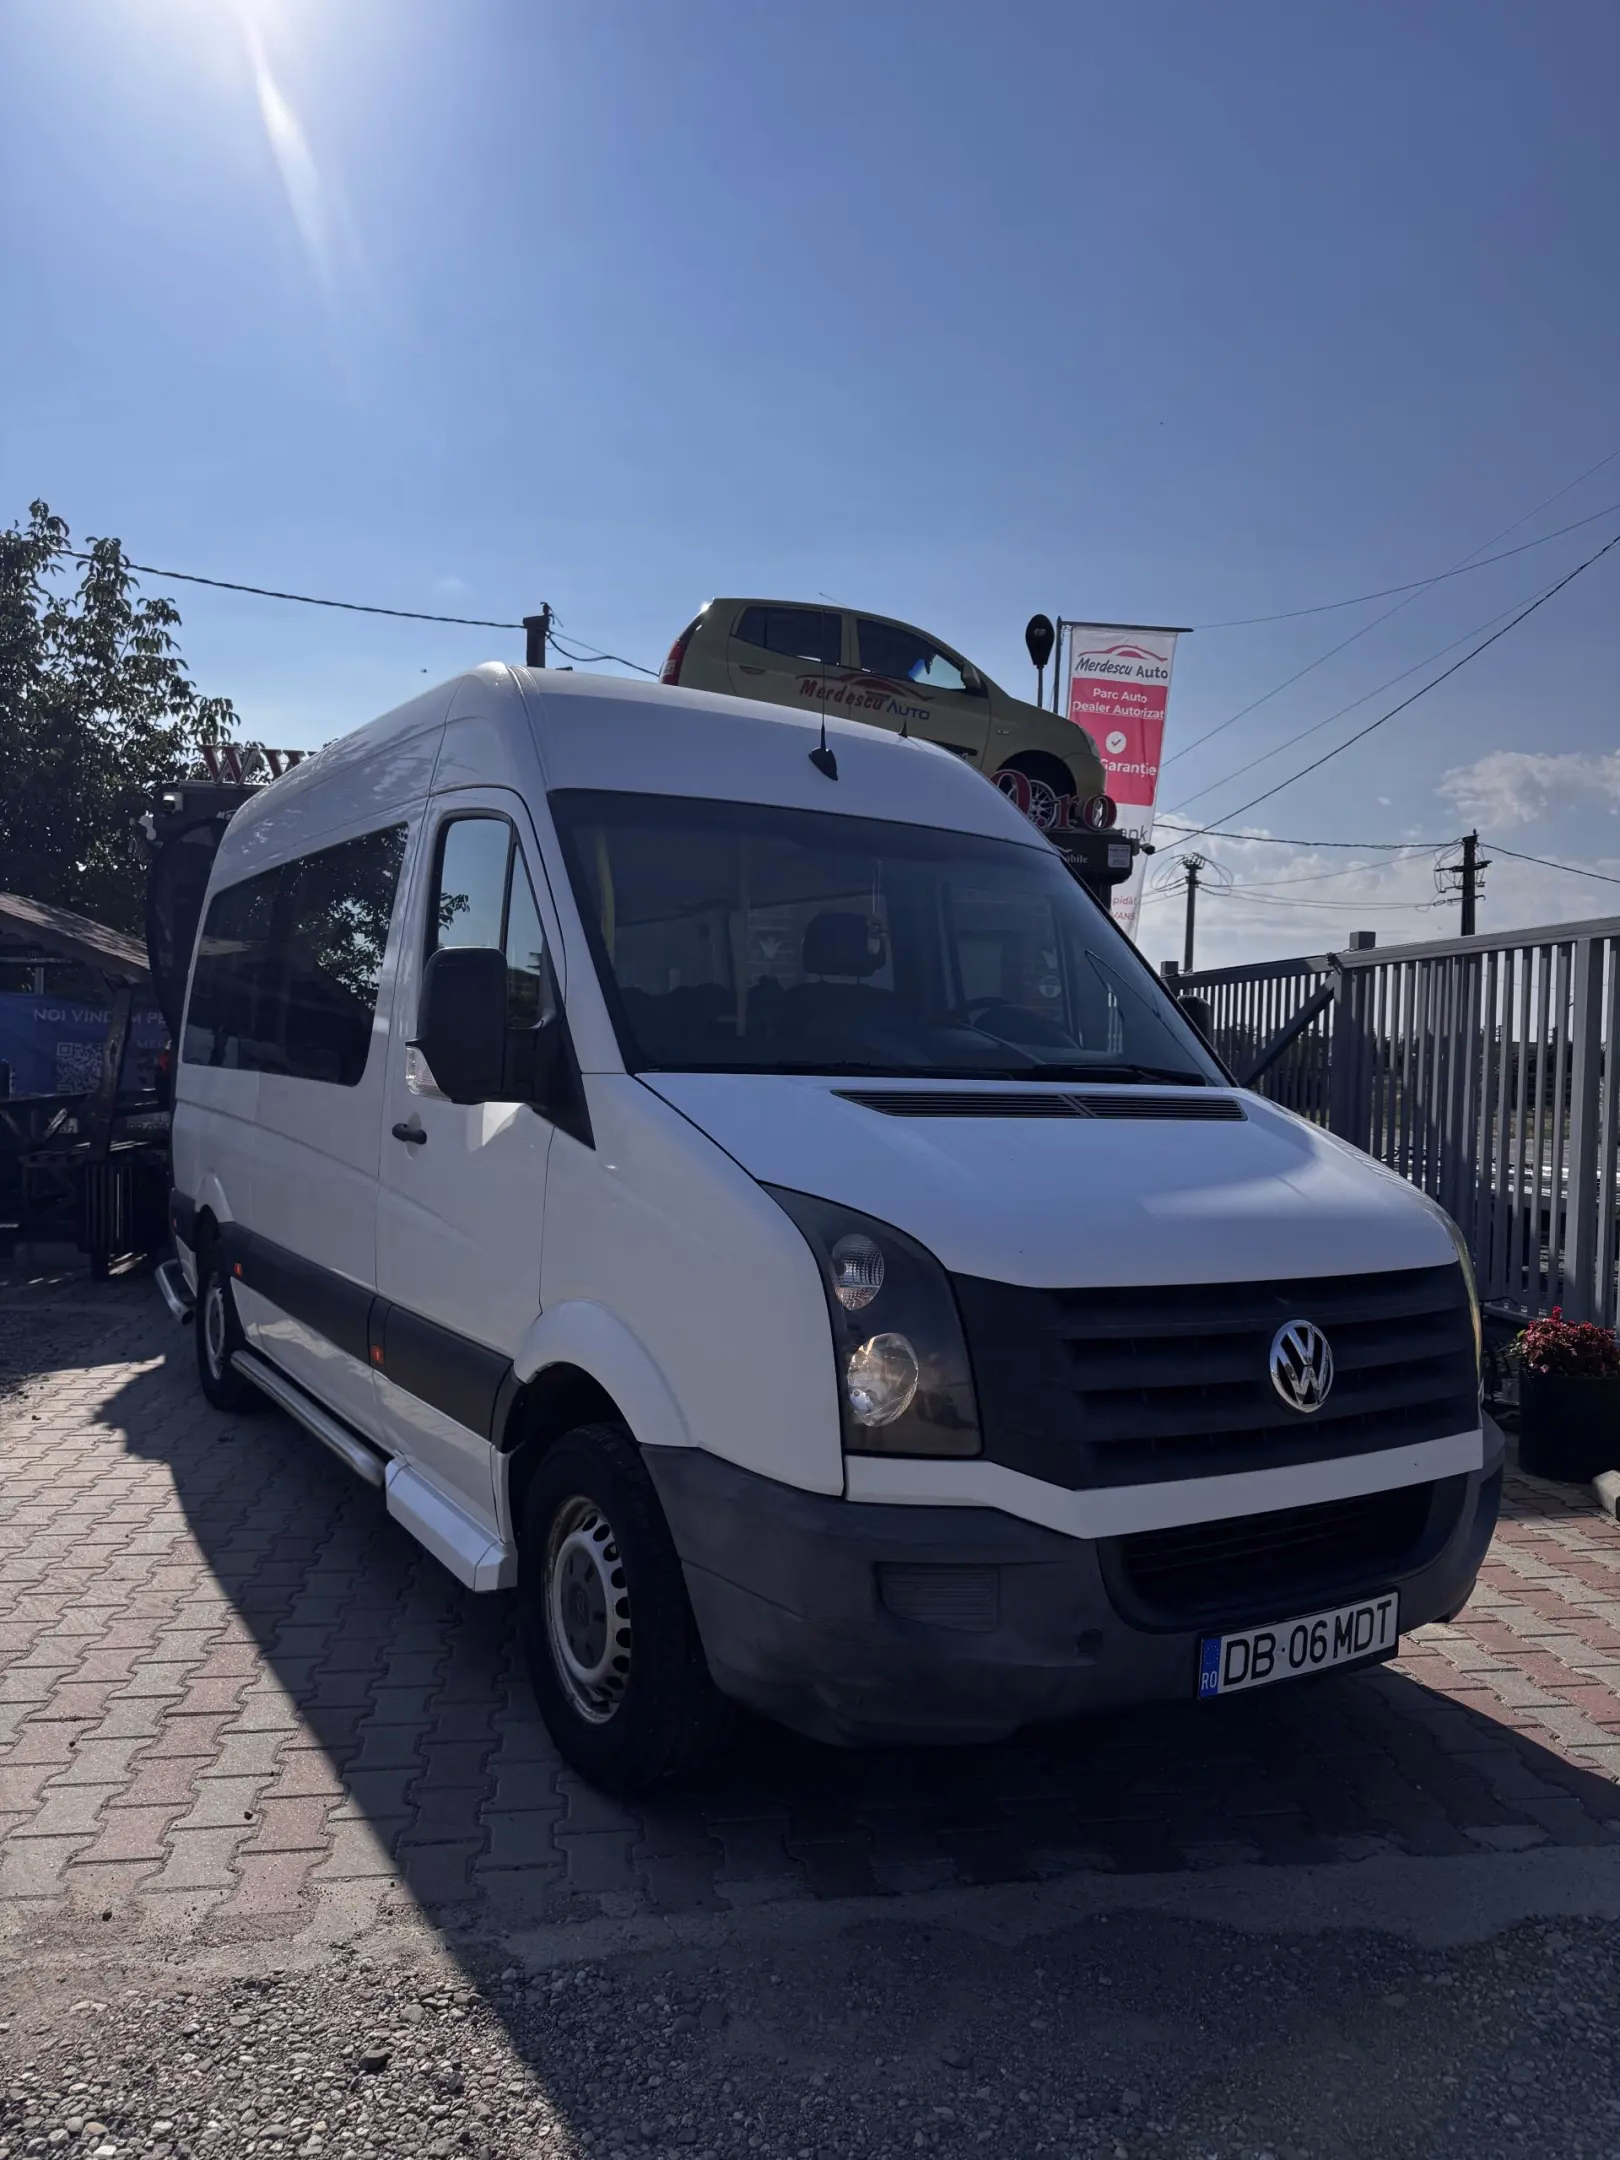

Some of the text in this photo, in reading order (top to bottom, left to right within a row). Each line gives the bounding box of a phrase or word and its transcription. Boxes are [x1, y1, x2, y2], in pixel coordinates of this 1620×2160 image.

[1075, 656, 1168, 680] Merdescu Auto
[799, 679, 884, 711] Merdescu
[1092, 687, 1148, 704] Parc Auto
[1072, 700, 1164, 720] Dealer Autorizat
[33, 1009, 66, 1022] NOI
[1201, 1671, 1217, 1690] RO
